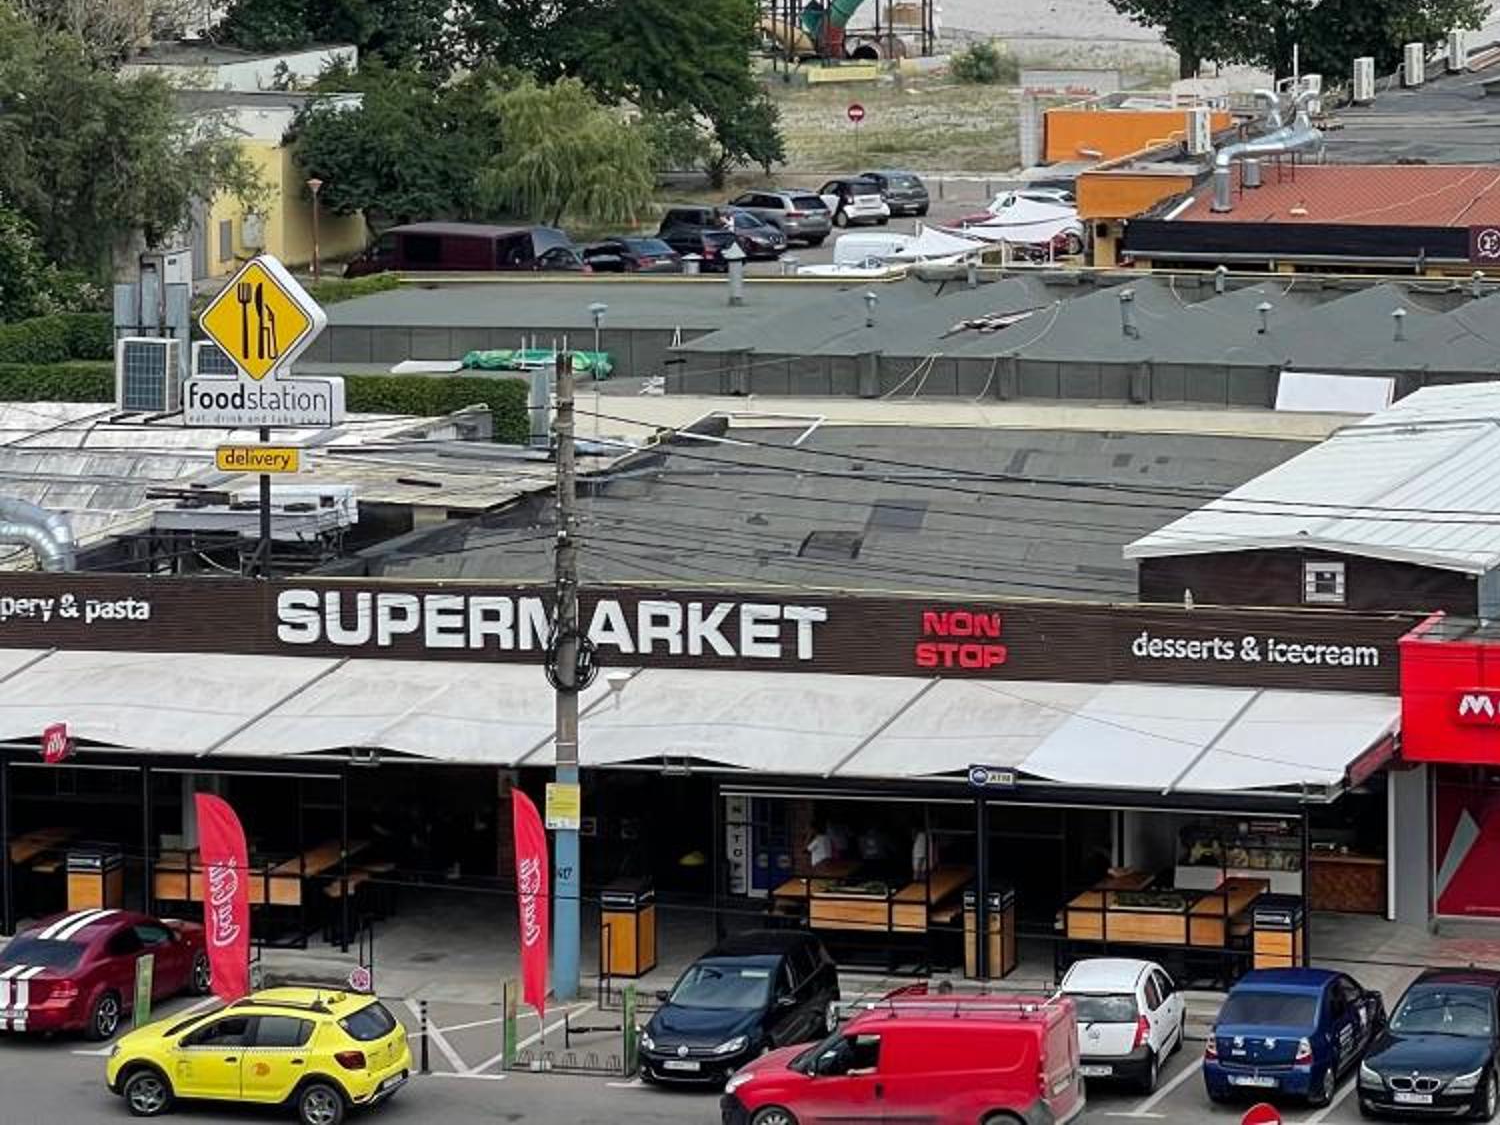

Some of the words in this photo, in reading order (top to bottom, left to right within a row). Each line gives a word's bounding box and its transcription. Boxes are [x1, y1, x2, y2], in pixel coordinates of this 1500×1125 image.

[189, 382, 328, 412] foodstation
[225, 448, 291, 470] delivery
[60, 593, 81, 620] &
[85, 599, 151, 624] pasta
[923, 611, 1001, 637] NON
[915, 642, 1008, 668] STOP
[1131, 632, 1235, 661] desserts
[1239, 636, 1262, 662] &
[1267, 638, 1379, 666] icecream
